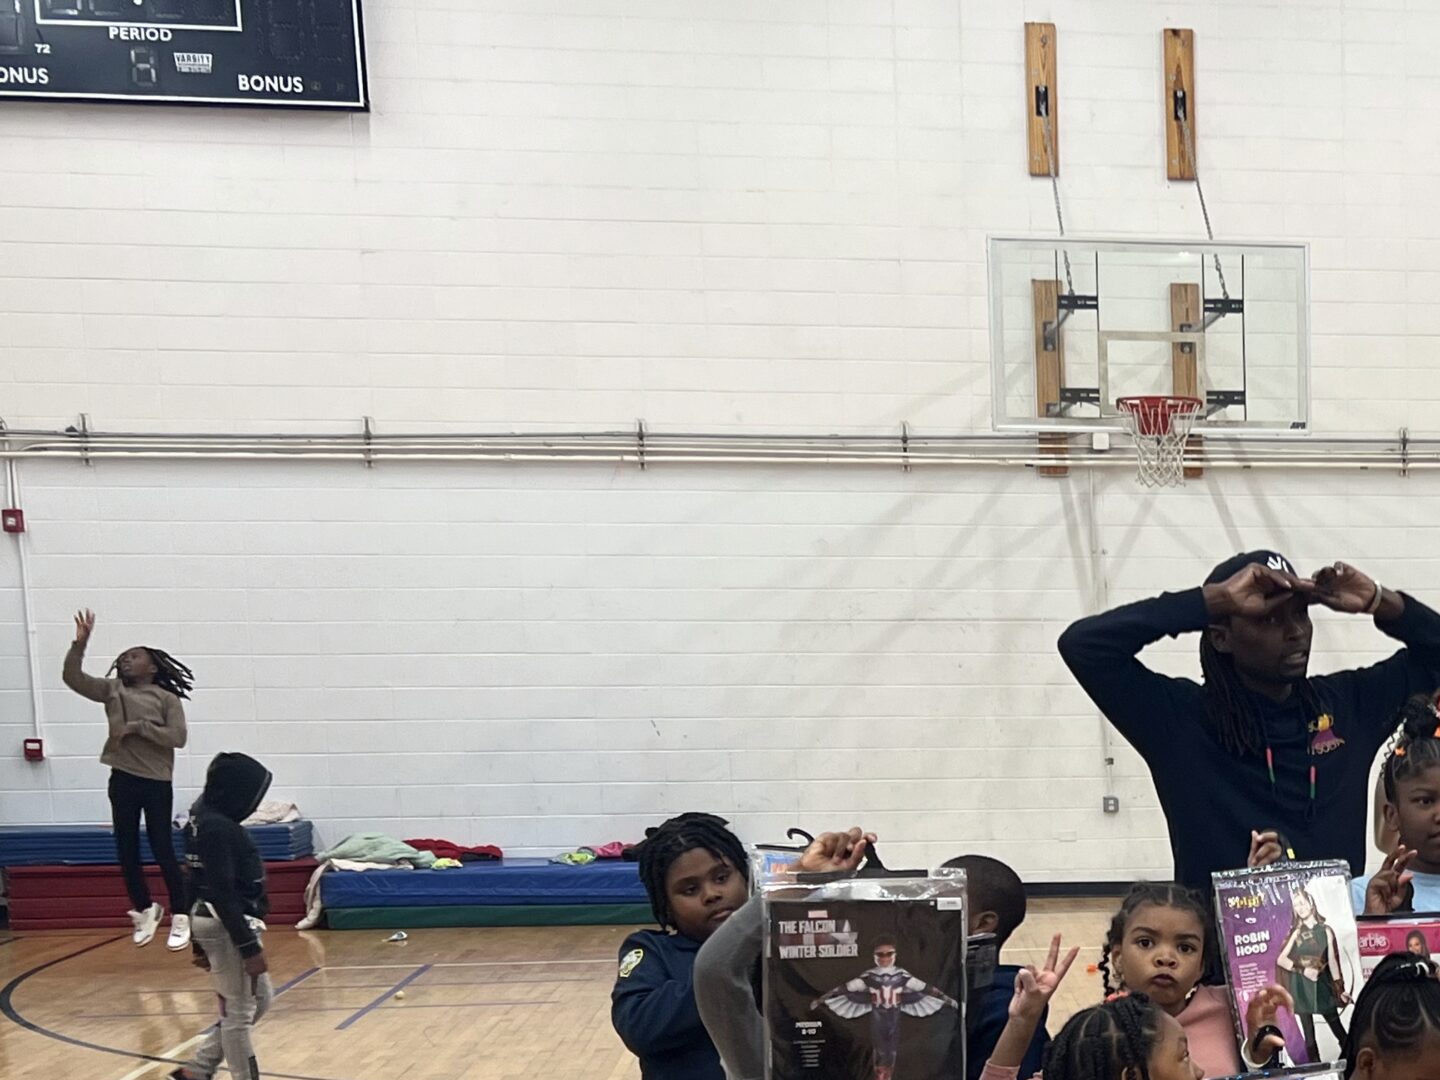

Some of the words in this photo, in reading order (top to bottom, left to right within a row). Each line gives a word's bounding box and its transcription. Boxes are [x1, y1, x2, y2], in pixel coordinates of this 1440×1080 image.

[108, 26, 173, 42] PERIOD
[34, 43, 51, 54] 72
[237, 74, 304, 94] BONUS
[779, 920, 798, 934] THE
[799, 919, 836, 934] FALCON
[1234, 929, 1271, 946] ROBIN
[779, 944, 817, 960] WINTER
[818, 943, 858, 958] SOLDIER
[1236, 942, 1268, 957] HOOD
